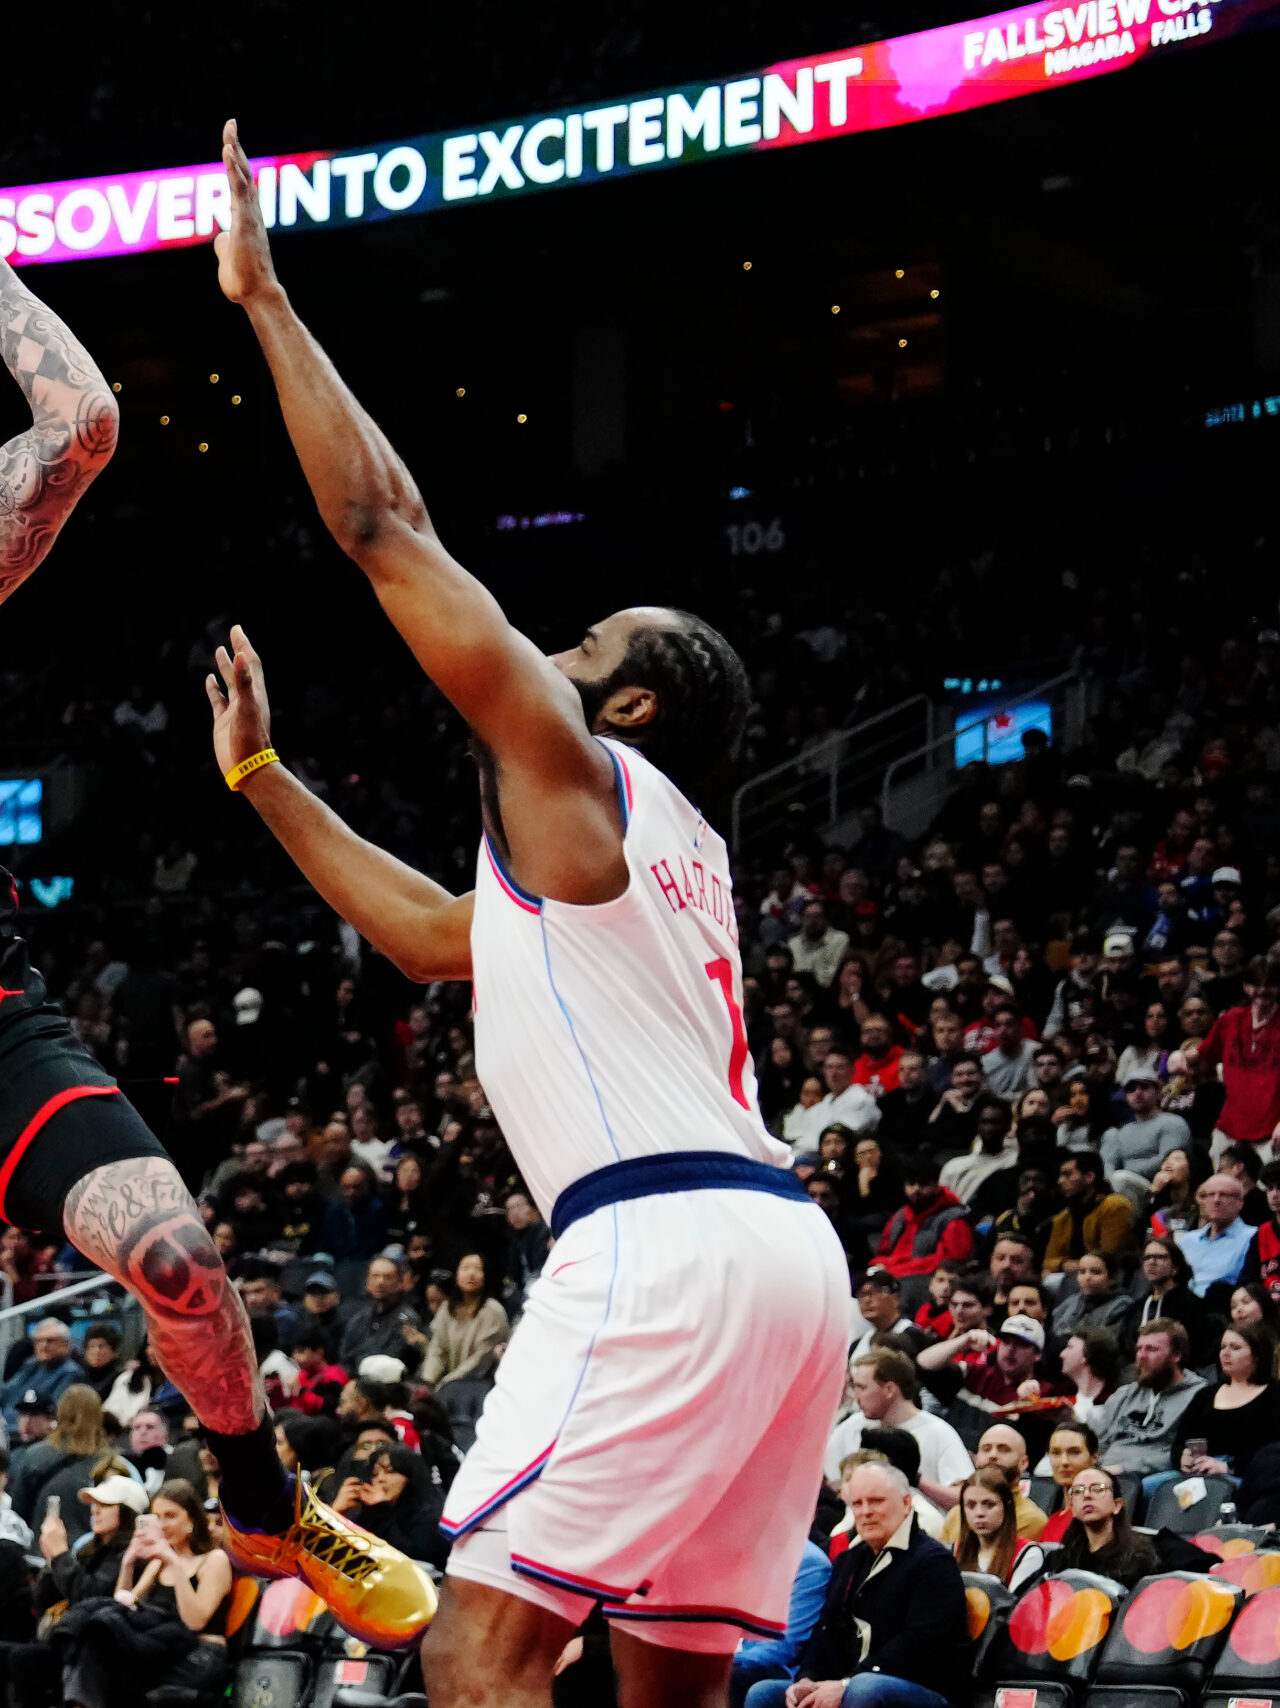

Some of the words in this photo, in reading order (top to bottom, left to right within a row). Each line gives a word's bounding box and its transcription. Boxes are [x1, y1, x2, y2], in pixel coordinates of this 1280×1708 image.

[963, 0, 1151, 70] FALLSVIEW
[1044, 31, 1136, 76] NIAGARA
[1150, 8, 1213, 47] FALLS
[258, 146, 427, 229] INTO
[442, 56, 864, 202] EXCITEMENT
[724, 517, 786, 556] 106
[705, 957, 751, 1111] 1
